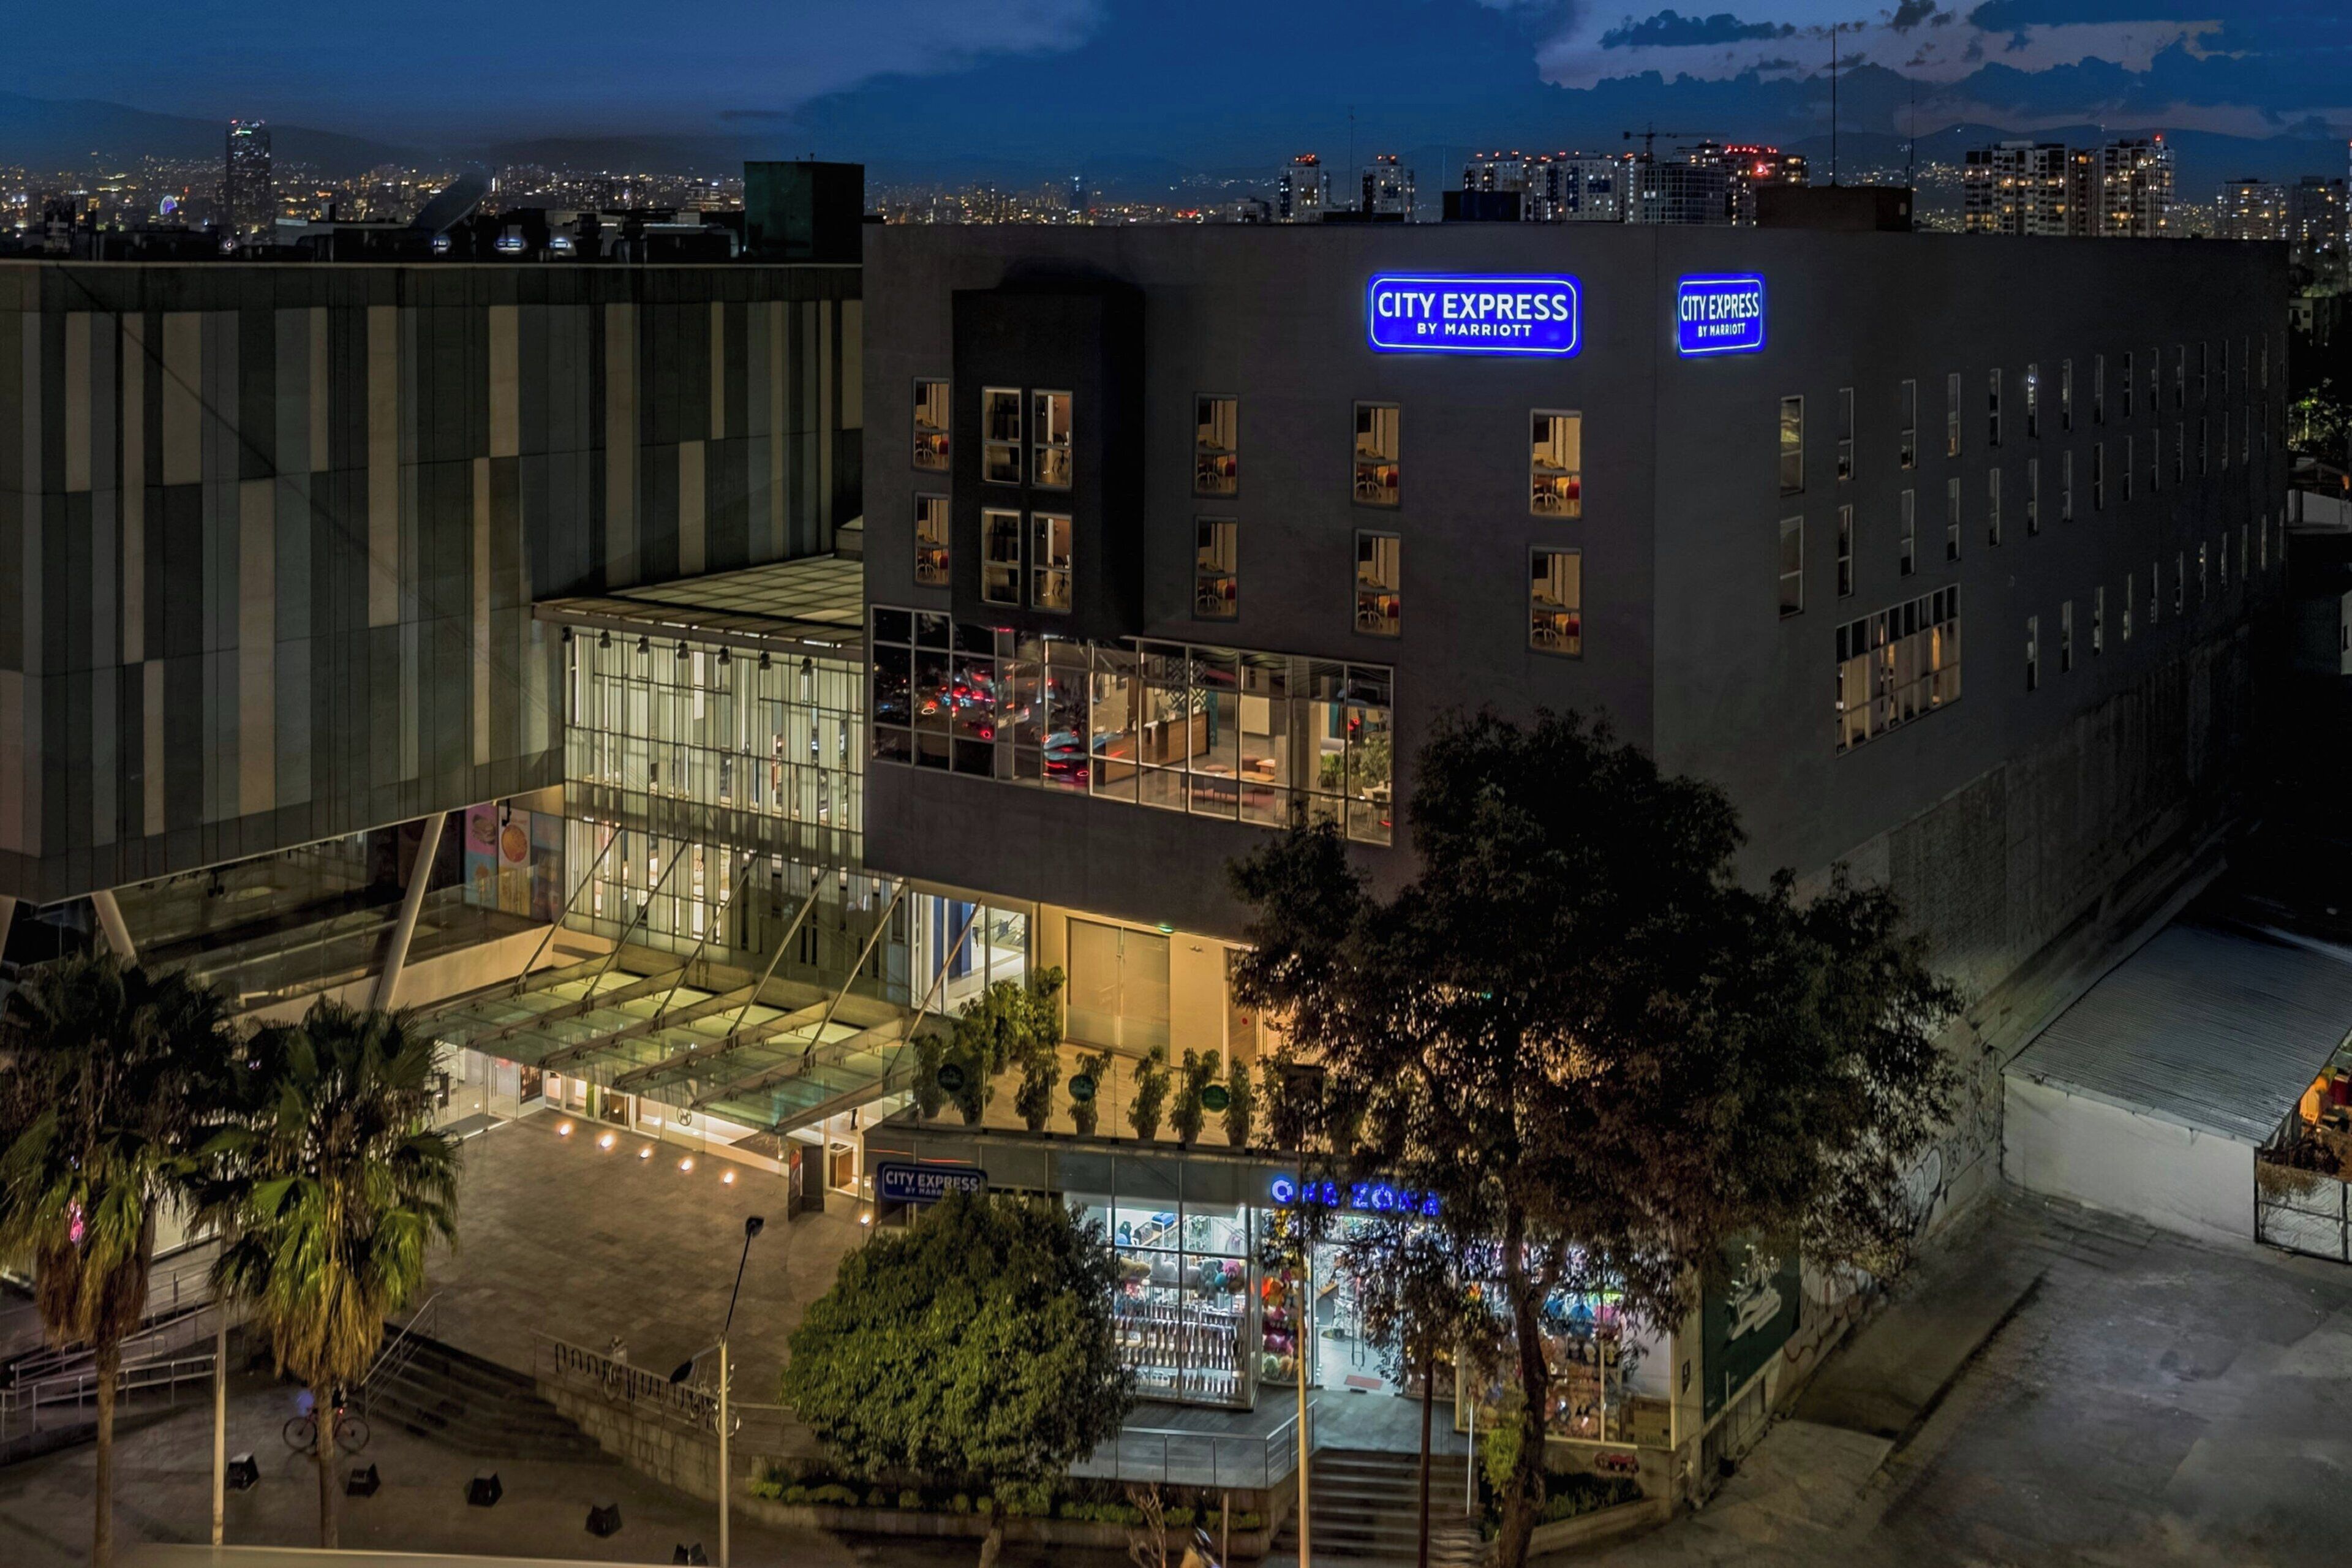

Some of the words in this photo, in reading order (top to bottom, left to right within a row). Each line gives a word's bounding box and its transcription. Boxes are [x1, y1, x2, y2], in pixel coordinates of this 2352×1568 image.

[1378, 292, 1436, 318] CITY
[1442, 293, 1569, 322] EXPRESS
[1681, 295, 1706, 322] CITY
[1709, 292, 1759, 320] EXPRESS
[1417, 322, 1438, 335] BY
[1445, 323, 1532, 337] MARRIOTT
[1698, 325, 1708, 337] BY
[1709, 322, 1746, 336] MARRIOTT
[886, 1170, 914, 1186] CITY
[918, 1174, 978, 1192] EXPRESS
